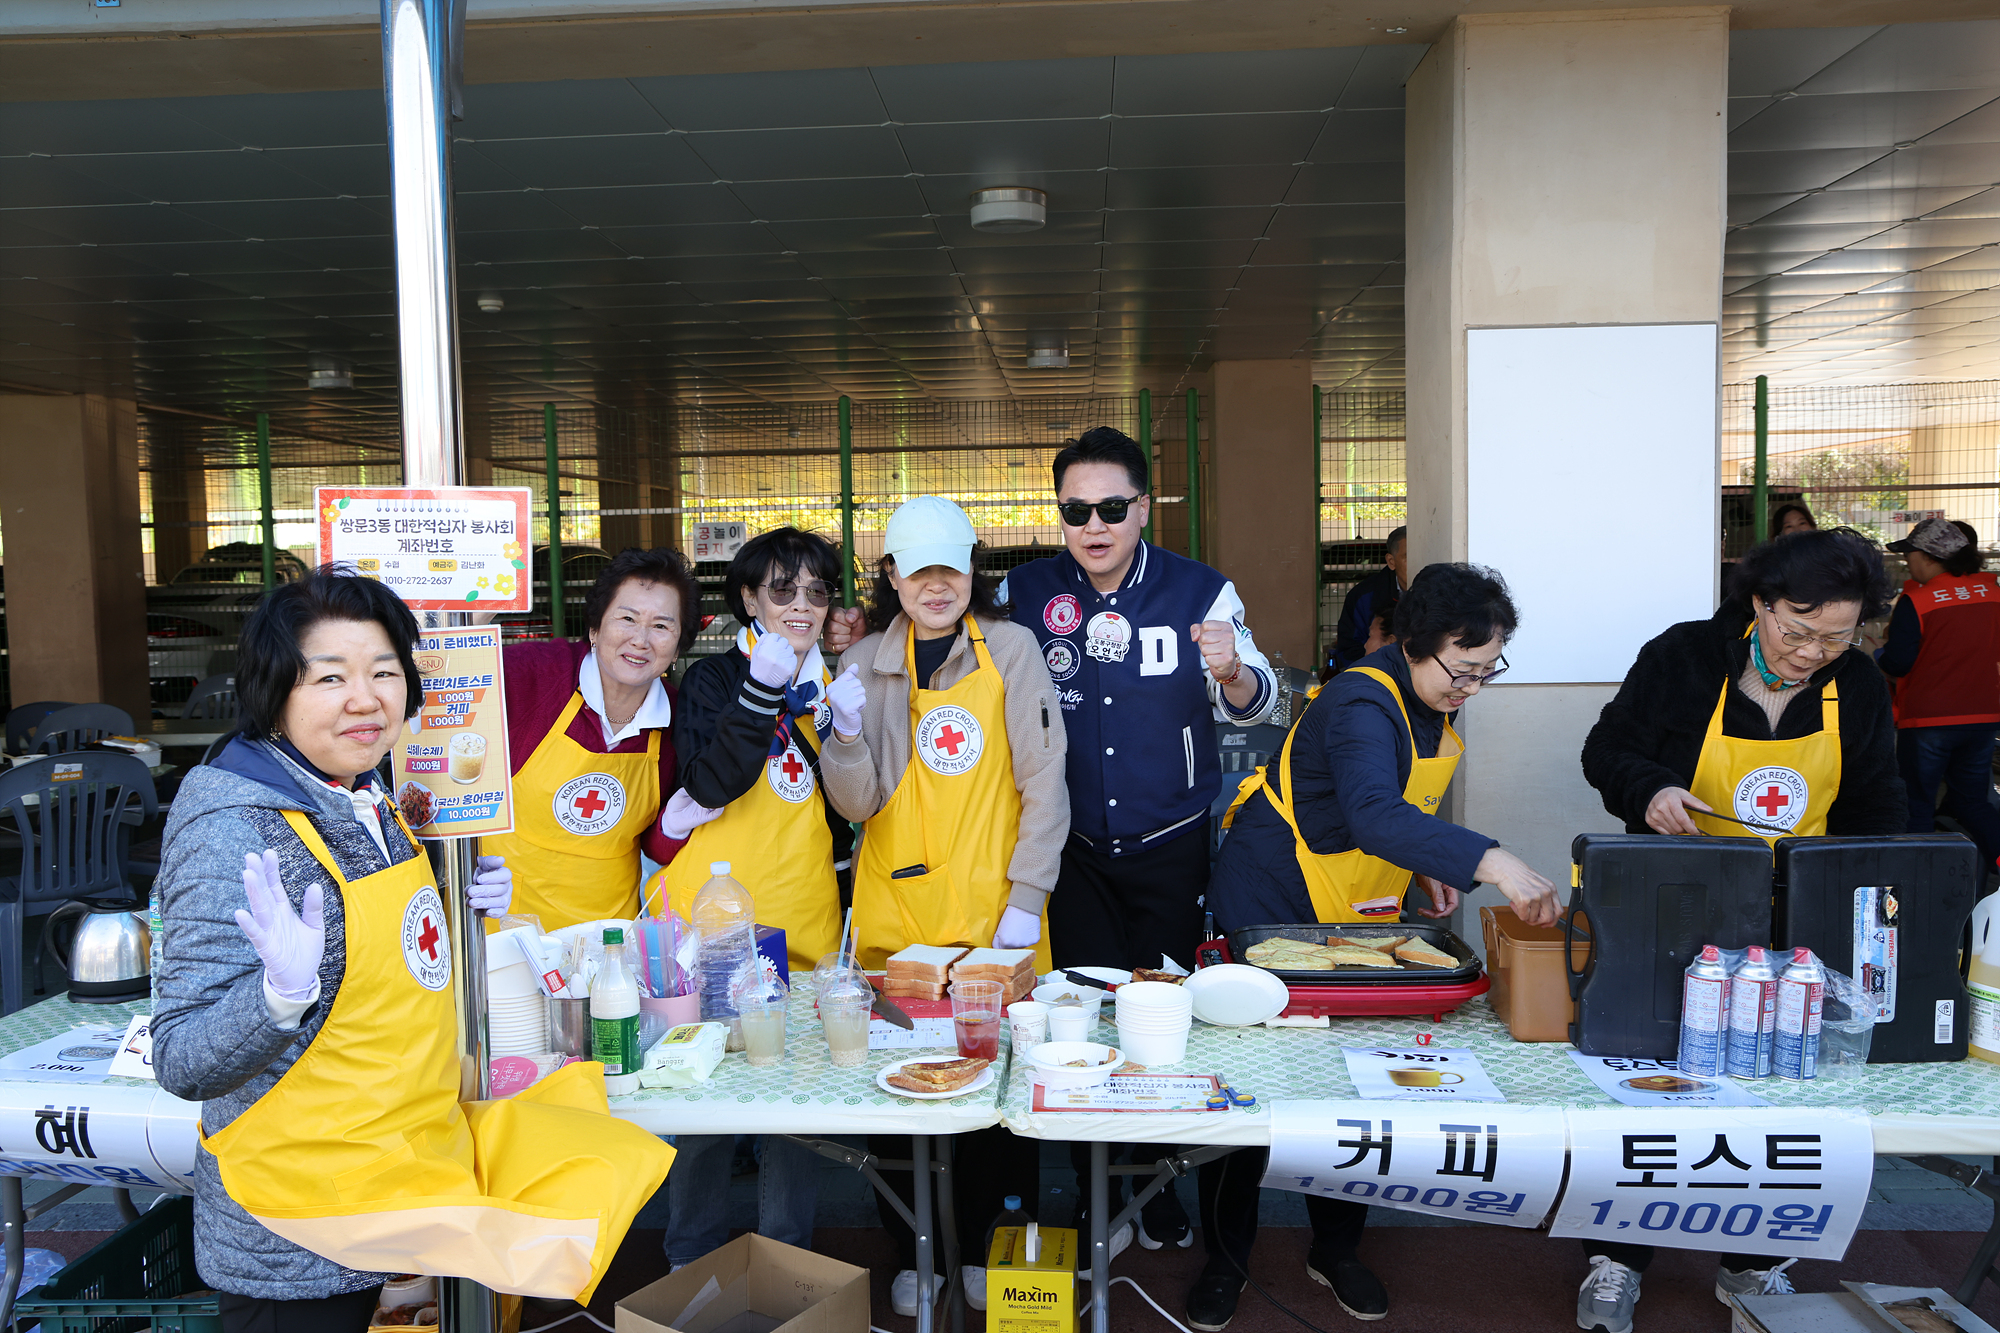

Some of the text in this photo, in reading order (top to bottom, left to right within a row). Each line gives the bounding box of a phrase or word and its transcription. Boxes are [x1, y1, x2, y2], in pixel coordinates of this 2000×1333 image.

[340, 519, 514, 534] 쌍문3동 대한적십자 봉사회
[699, 526, 740, 540] 공놀이
[398, 538, 454, 553] 계좌번호
[697, 543, 724, 556] 금지
[384, 561, 400, 569] 수협
[432, 561, 454, 569] 예금주
[460, 560, 485, 570] 김난화
[384, 576, 452, 585] 1010-2722-2637
[1932, 584, 1988, 602] 도봉구
[444, 635, 497, 650] 준비했다.
[1139, 626, 1178, 676] D
[1062, 666, 1076, 678] SOCKS
[422, 674, 492, 690] 프렌치토스트
[438, 692, 474, 703] 1,000원
[447, 703, 470, 714] 커피
[428, 716, 464, 727] 1,000원
[921, 710, 976, 748] KOREAN RED CROSS
[407, 744, 443, 756] 식혜(수제)
[411, 761, 440, 770] 2,000원
[934, 749, 977, 771] 대한적십자사
[561, 777, 620, 807] KOREAN RED CROSS
[778, 781, 811, 798] 대한적십자사
[1740, 773, 1766, 802] KOREAN
[1788, 776, 1803, 799] CROSS
[434, 791, 504, 807] (국산) 홍어무침
[449, 807, 490, 820] 10,000원
[562, 812, 608, 832] 대한적십자사
[406, 902, 420, 951] KOREAN
[420, 894, 430, 906] RED
[420, 950, 448, 984] 대한적십자사
[34, 1104, 98, 1159] 혜
[1616, 1134, 1822, 1189] 토스트
[1294, 1176, 1527, 1216] 1,000원
[1590, 1200, 1834, 1242] 1,000원
[1002, 1286, 1058, 1302] Maxim
